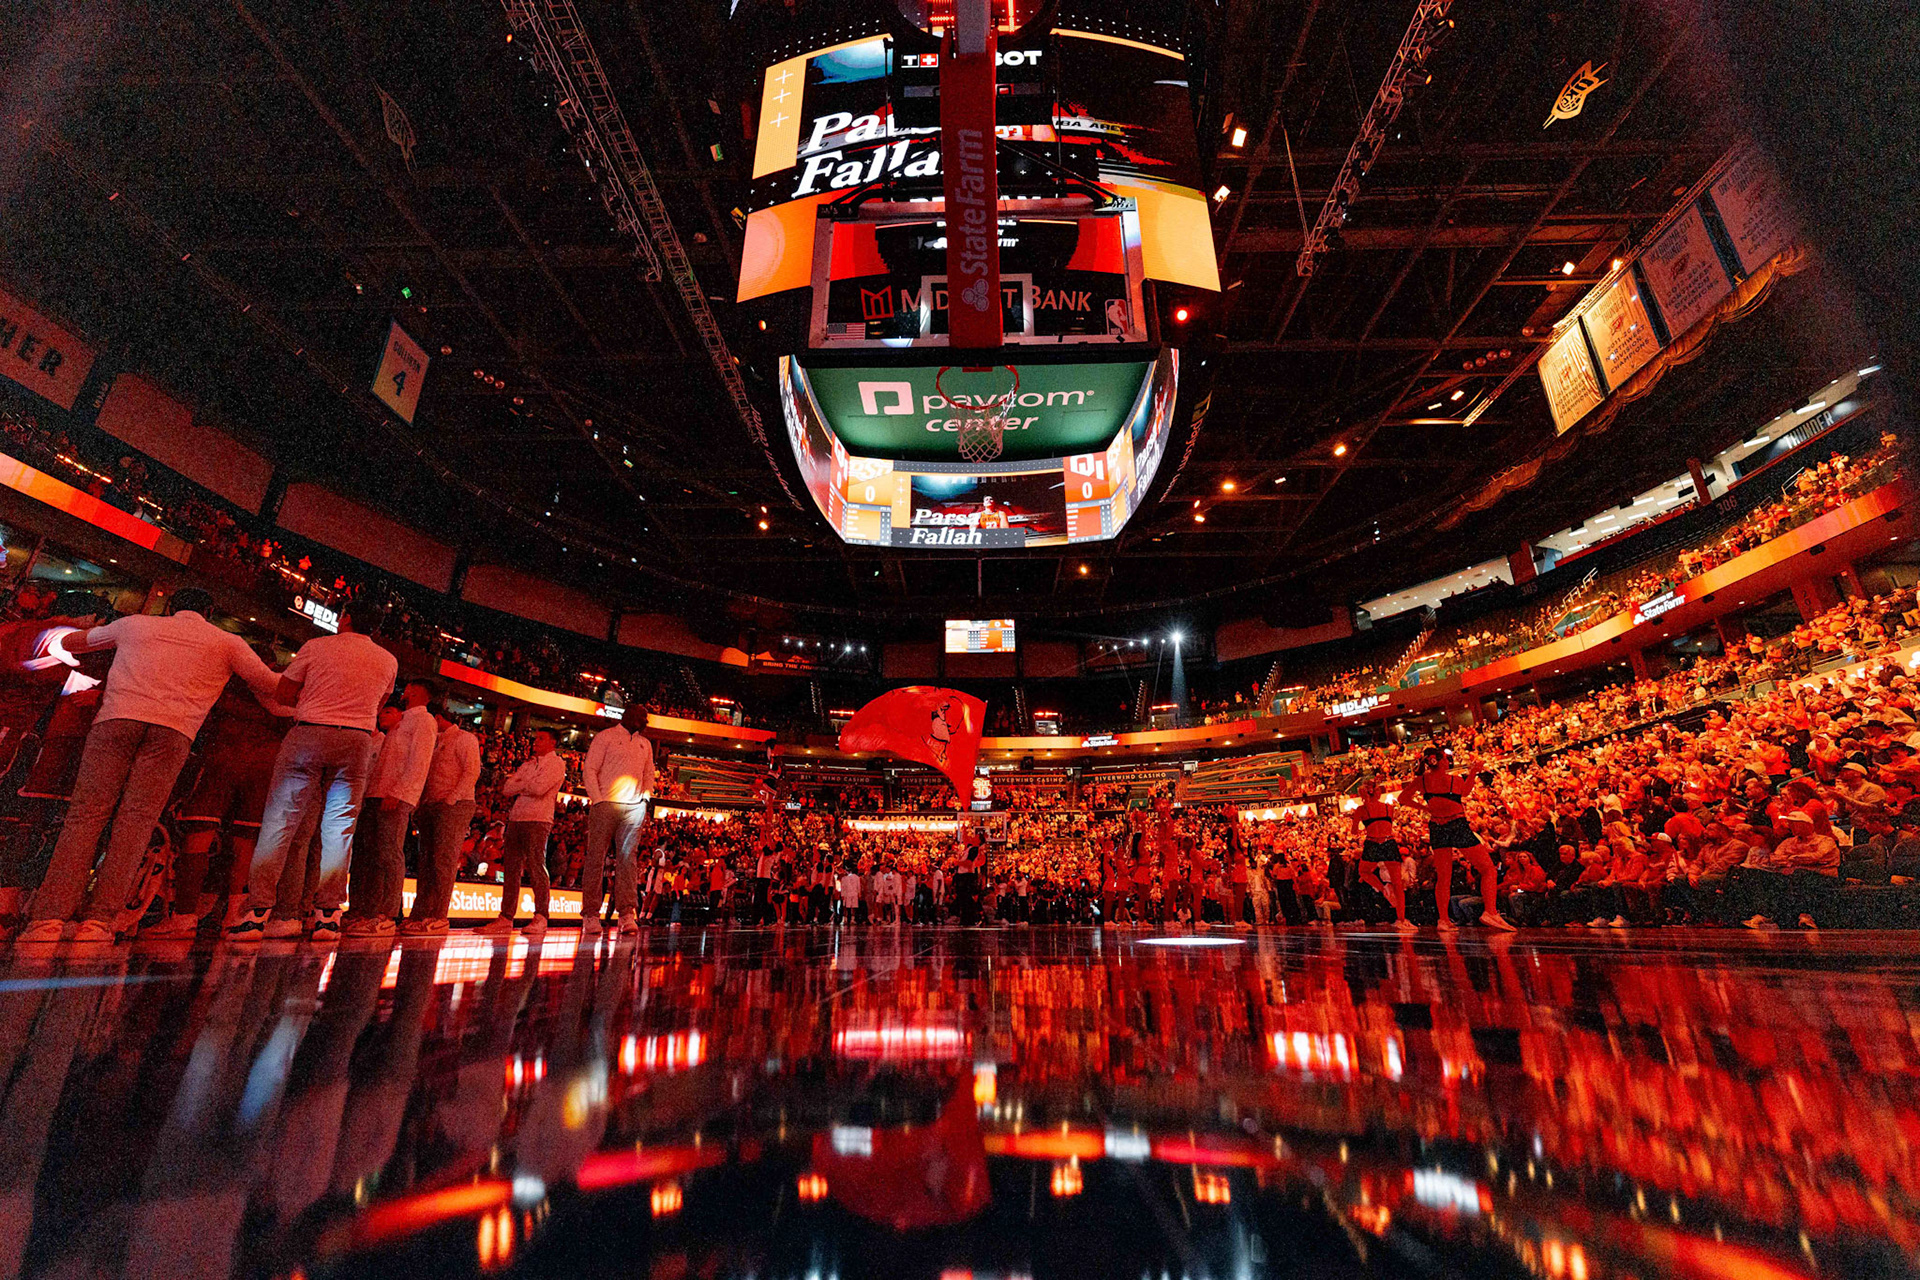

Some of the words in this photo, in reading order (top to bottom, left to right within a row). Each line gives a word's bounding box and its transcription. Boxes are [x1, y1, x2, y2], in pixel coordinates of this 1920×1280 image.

[393, 370, 406, 397] 4
[1783, 410, 1836, 449] THUNDER
[865, 485, 875, 502] 0
[1082, 482, 1093, 499] 0
[911, 508, 980, 526] Parsa
[909, 526, 983, 545] Fallah
[1331, 695, 1378, 715] BEDLAM
[1095, 773, 1136, 782] RIVERWIND
[1138, 771, 1167, 780] CASINO
